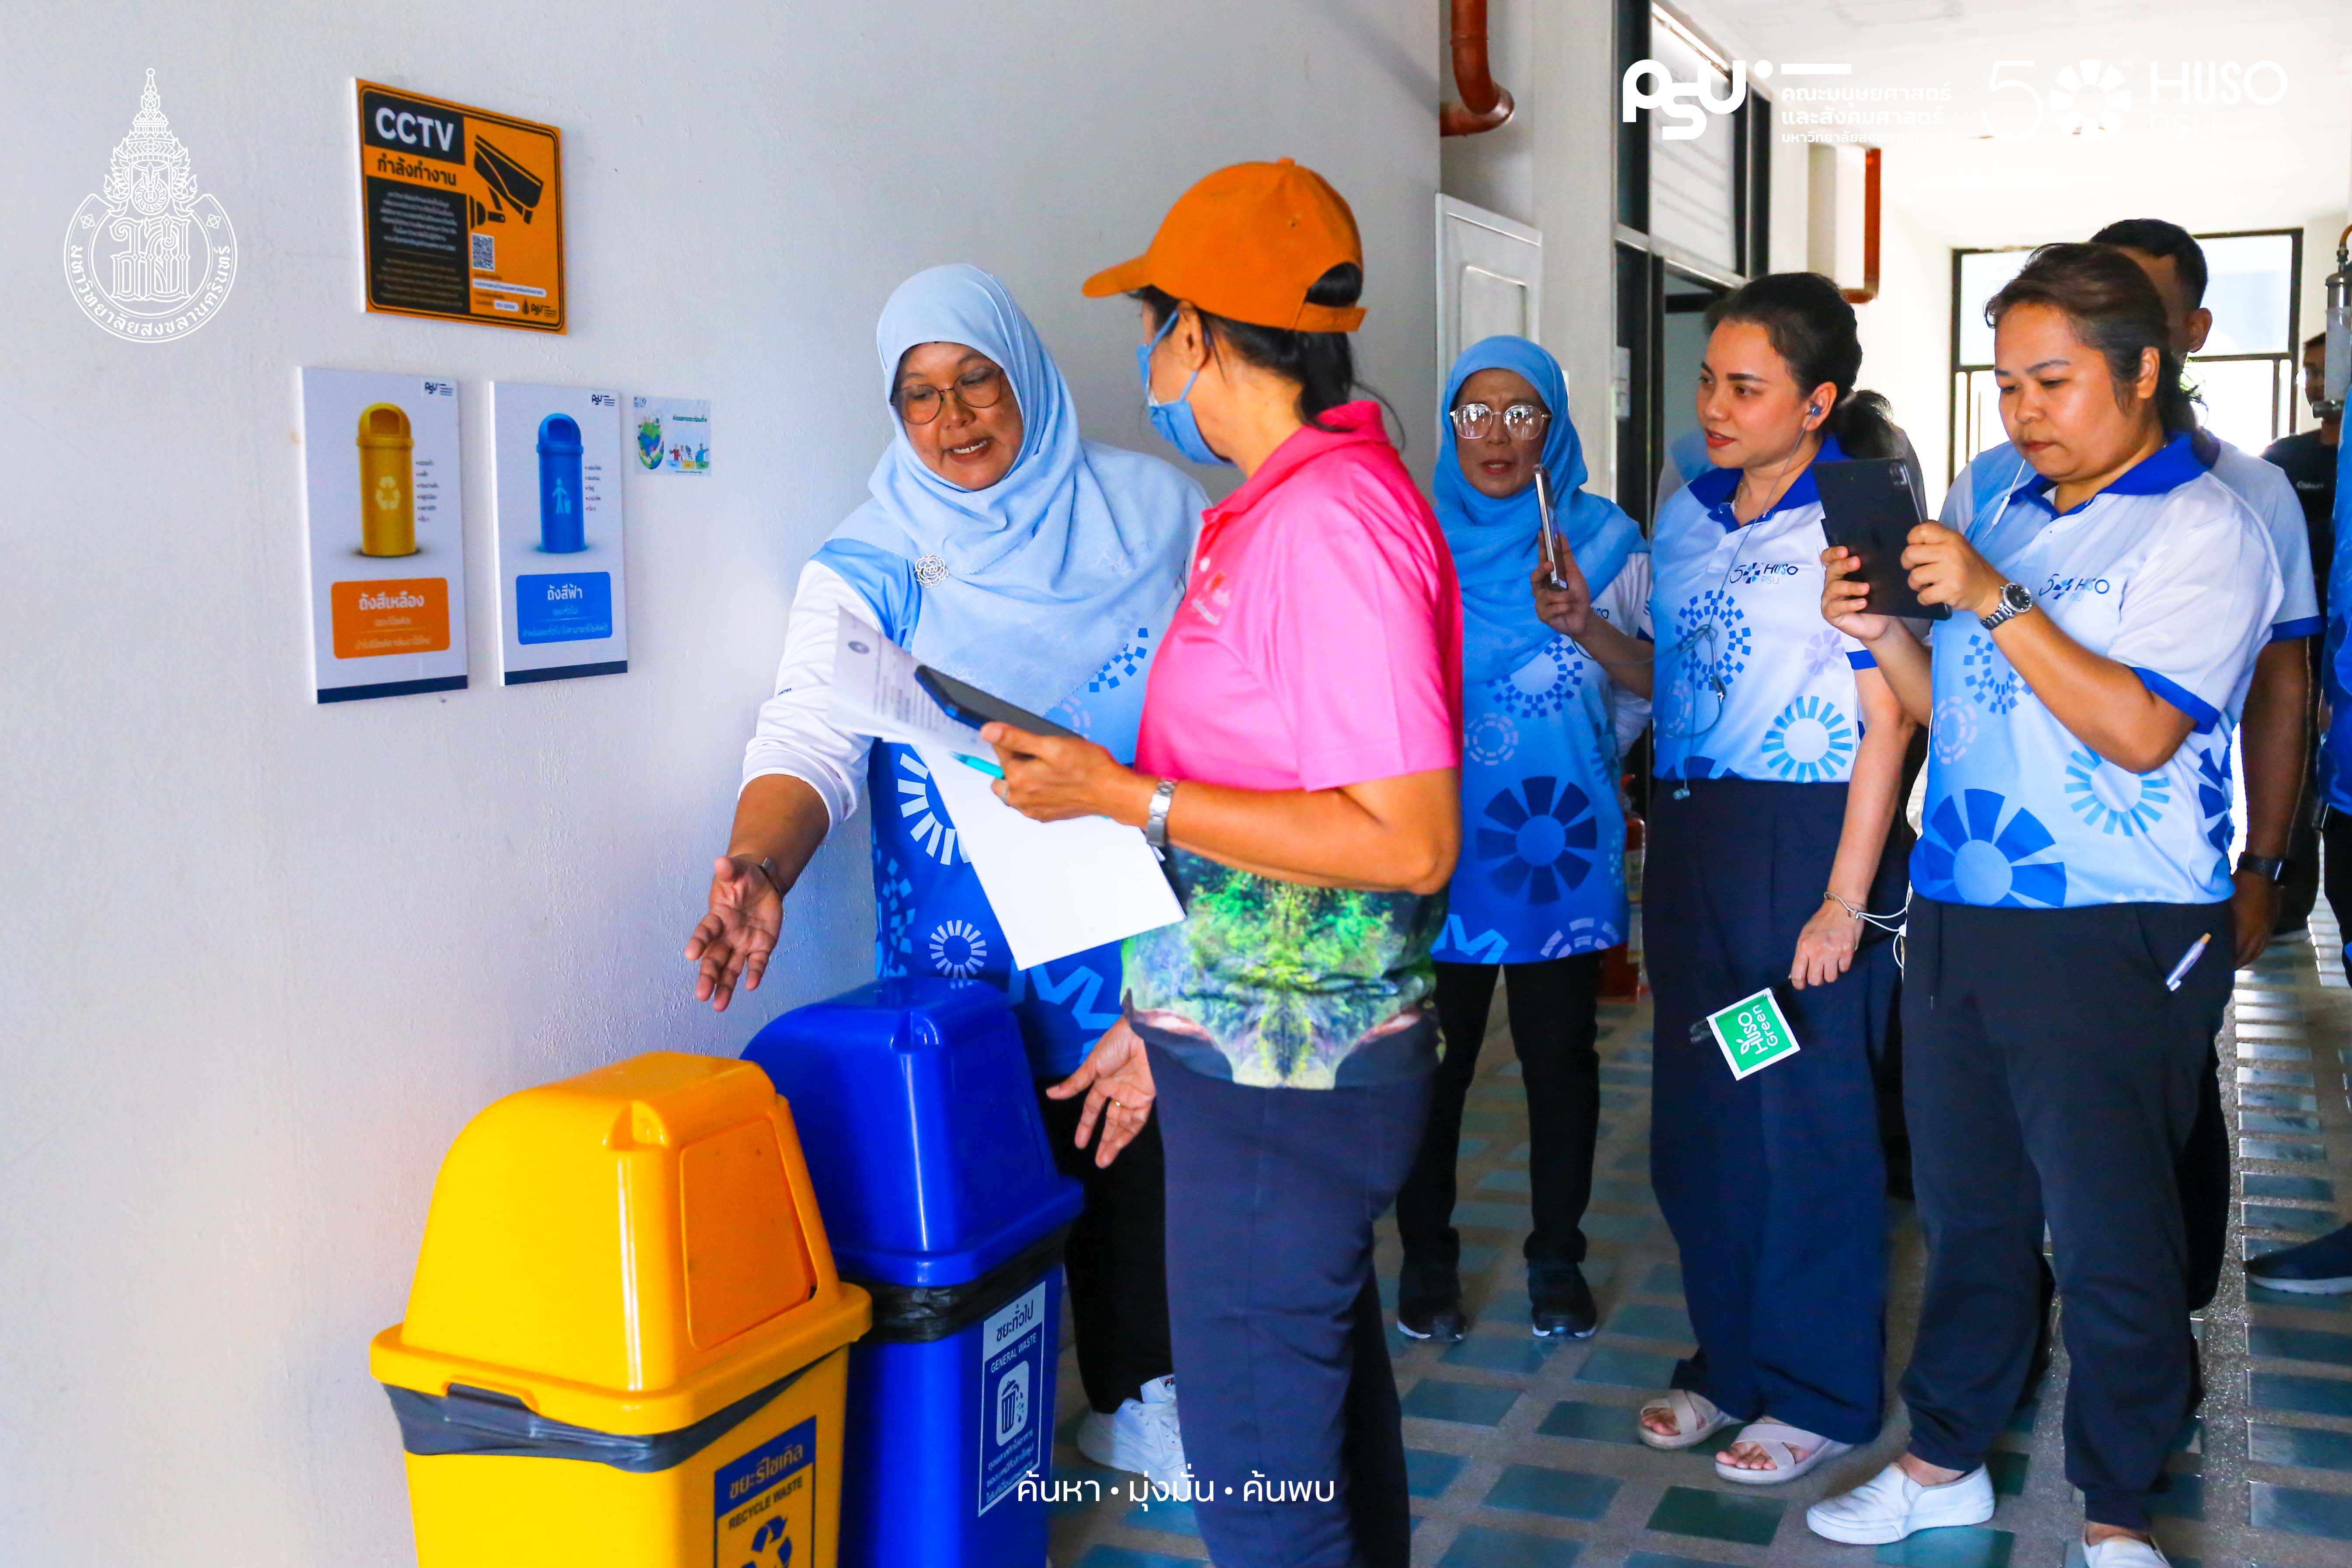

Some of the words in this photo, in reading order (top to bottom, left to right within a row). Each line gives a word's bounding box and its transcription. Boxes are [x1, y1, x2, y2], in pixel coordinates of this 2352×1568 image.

[376, 107, 454, 152] CCTV
[378, 153, 457, 186] กำลังทำงาน
[359, 590, 425, 611] ถังสีเหลือง
[547, 584, 583, 600] ถังสีฟ้า
[1738, 1012, 1769, 1055] HUSO
[1752, 1004, 1778, 1047] Green
[996, 1300, 1034, 1342] ขยะทั่วไป
[991, 1348, 1017, 1373] GENERAL
[1018, 1332, 1037, 1353] WASTE
[729, 1443, 803, 1499] ขยะรีไซเคิล
[729, 1495, 771, 1530] RECYCLE
[773, 1476, 803, 1502] WASTE
